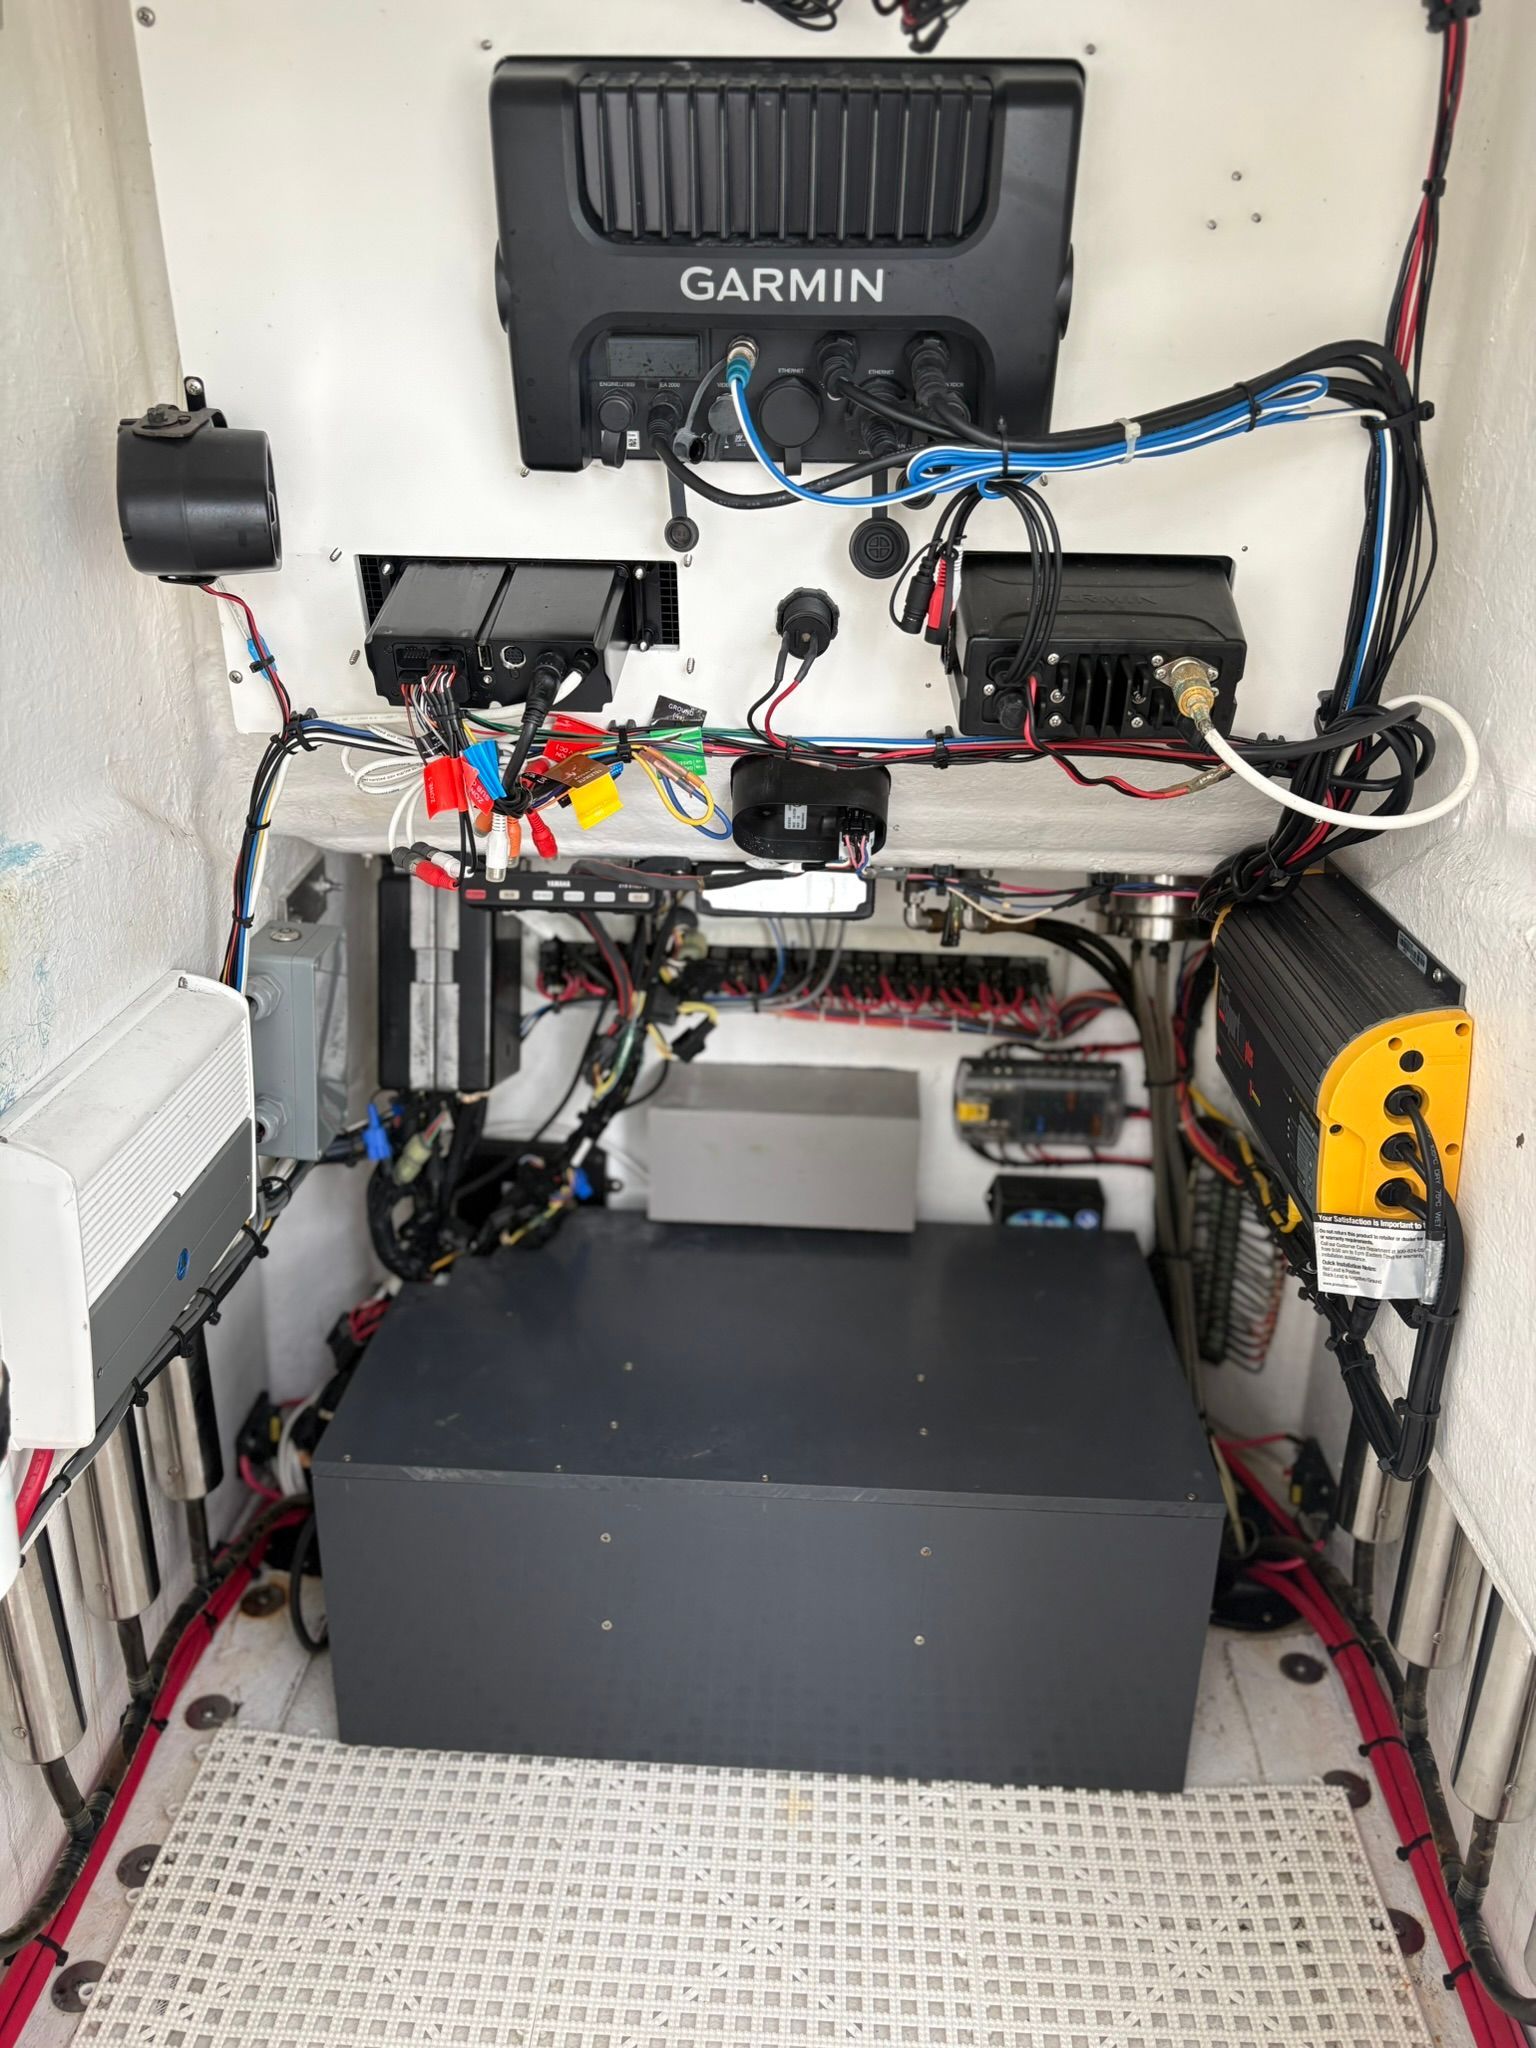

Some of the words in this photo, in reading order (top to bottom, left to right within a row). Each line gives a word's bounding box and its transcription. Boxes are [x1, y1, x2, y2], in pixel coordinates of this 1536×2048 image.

[680, 266, 884, 302] GARMIN
[668, 703, 695, 716] GROUND
[547, 880, 571, 888] YAMAHA
[1433, 1169, 1441, 1184] DRY
[1318, 1214, 1333, 1222] Your
[1333, 1215, 1372, 1226] Satisfaction
[1372, 1219, 1380, 1227] is
[1380, 1220, 1414, 1229] Important
[1414, 1222, 1423, 1230] to
[1434, 1211, 1442, 1227] WET
